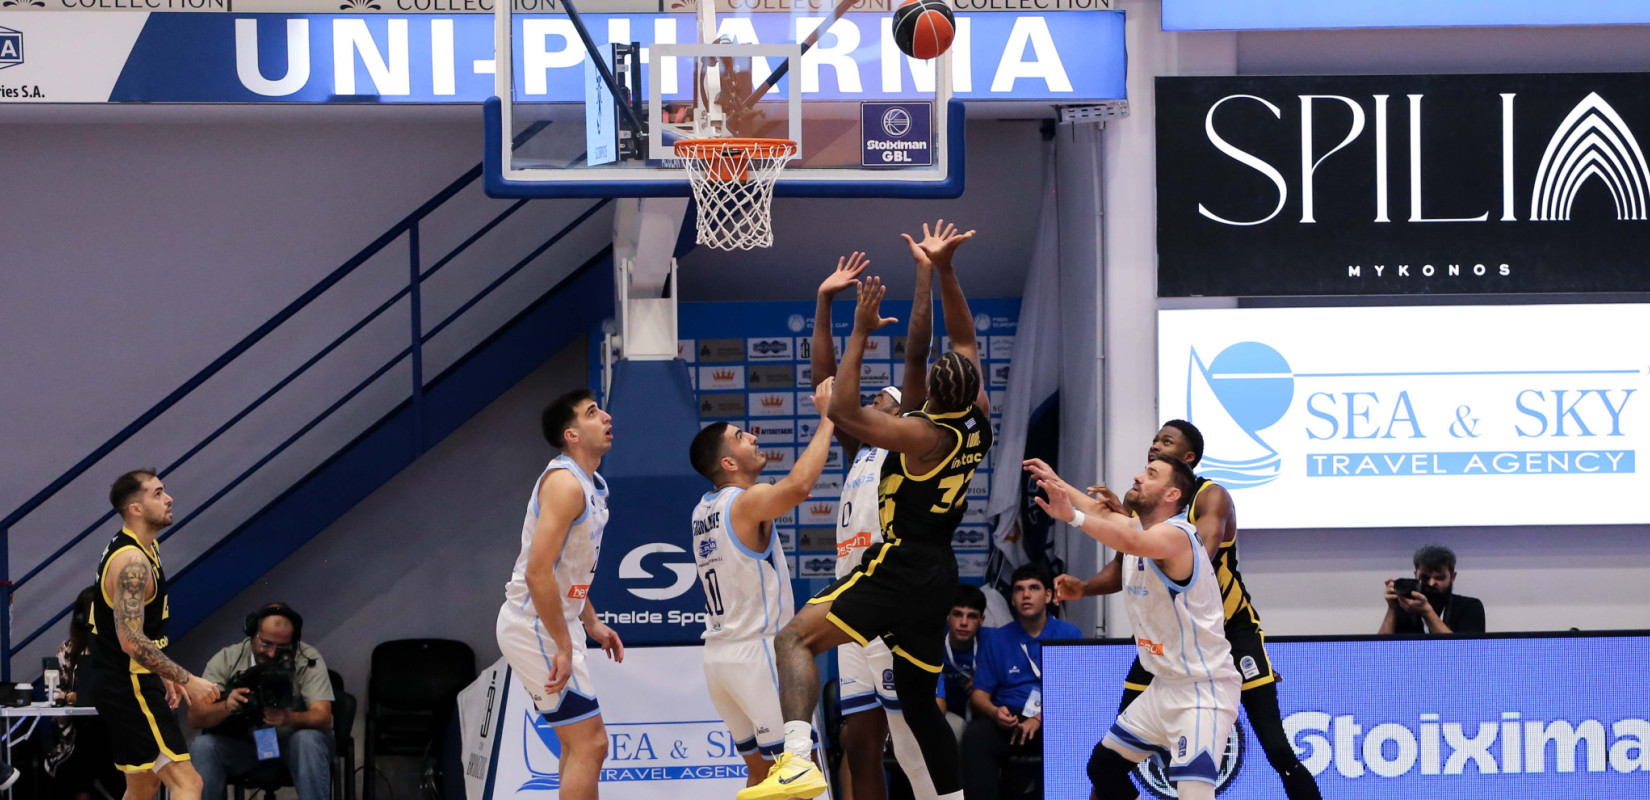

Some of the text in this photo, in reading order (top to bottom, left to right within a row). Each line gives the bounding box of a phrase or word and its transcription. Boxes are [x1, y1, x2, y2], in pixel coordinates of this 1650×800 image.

[397, 0, 556, 11] COLLECION
[21, 85, 46, 98] S.A.
[866, 139, 927, 150] Stoiximan
[881, 150, 912, 162] GBL
[1348, 263, 1511, 278] MYKONOS
[1305, 387, 1638, 440] SEA & SKY
[1312, 450, 1627, 476] TRAVEL AGENCY
[605, 732, 659, 761] EA
[669, 739, 689, 760] &
